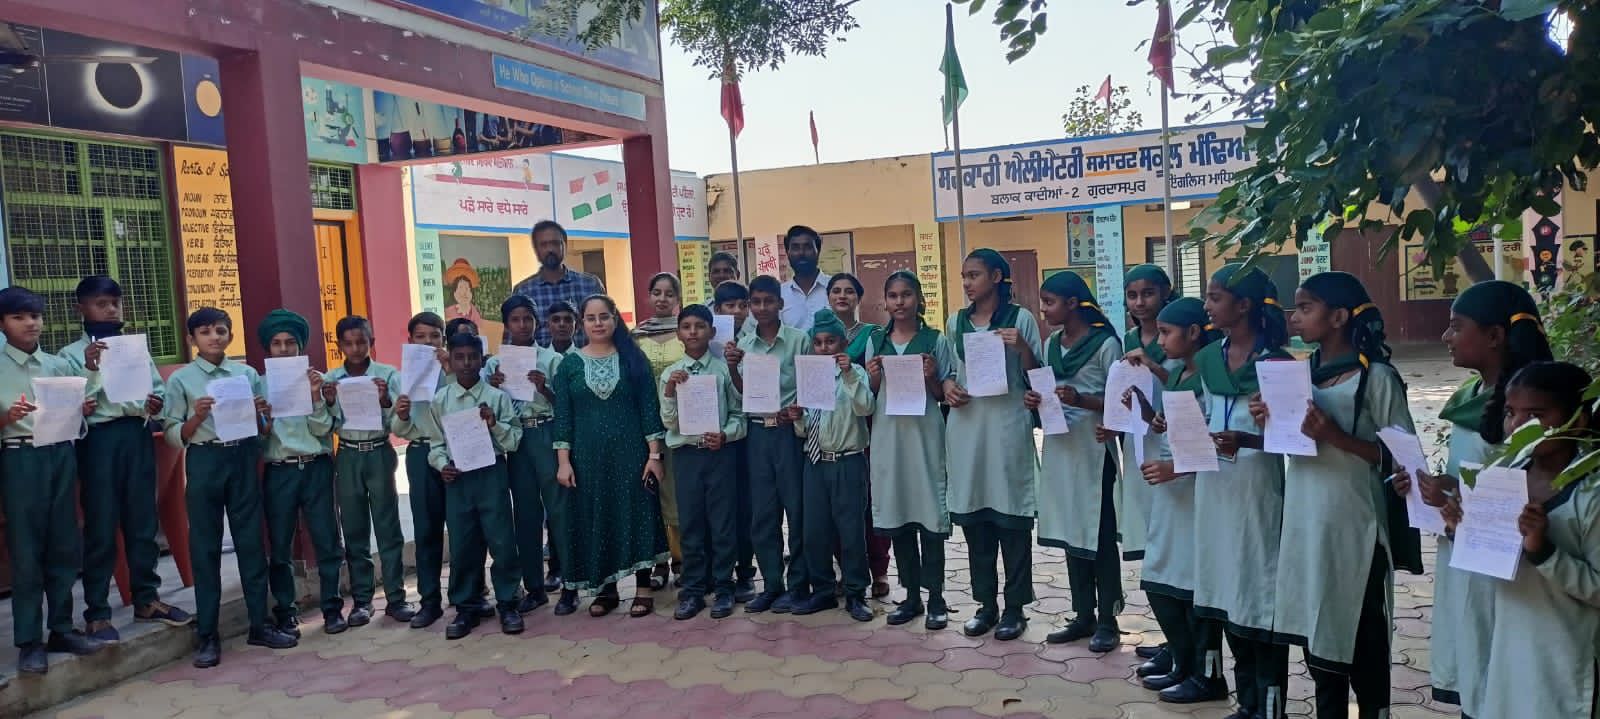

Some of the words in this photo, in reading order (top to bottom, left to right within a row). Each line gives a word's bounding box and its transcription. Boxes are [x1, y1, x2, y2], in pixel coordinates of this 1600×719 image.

[1086, 151, 1138, 172] ਸਮਾਰਟ
[184, 192, 202, 202] NOUN
[991, 192, 1021, 205] ਬਲਾਕ
[1087, 180, 1146, 199] ਗੁਰਦਾਸਪੁਰ
